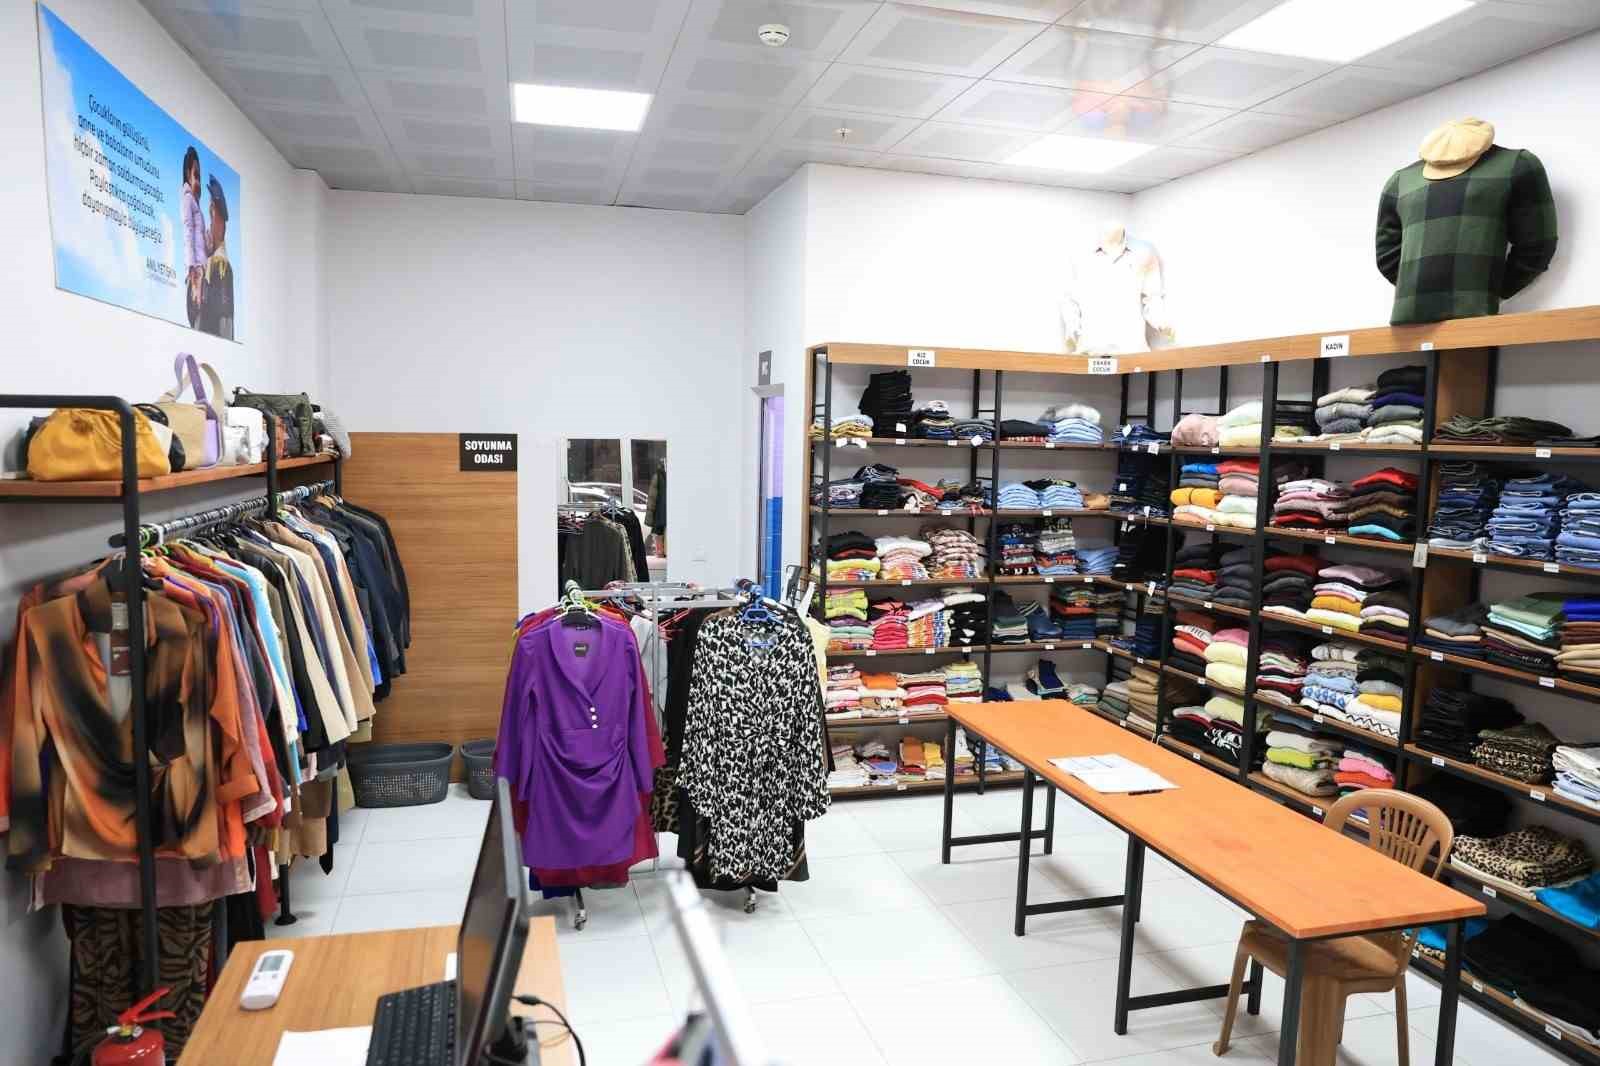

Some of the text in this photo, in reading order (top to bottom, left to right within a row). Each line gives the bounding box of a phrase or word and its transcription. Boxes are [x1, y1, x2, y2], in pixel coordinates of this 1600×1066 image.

[1325, 342, 1343, 352] KADIN
[464, 440, 513, 451] SOYUNMA
[474, 453, 504, 464] ODASI
